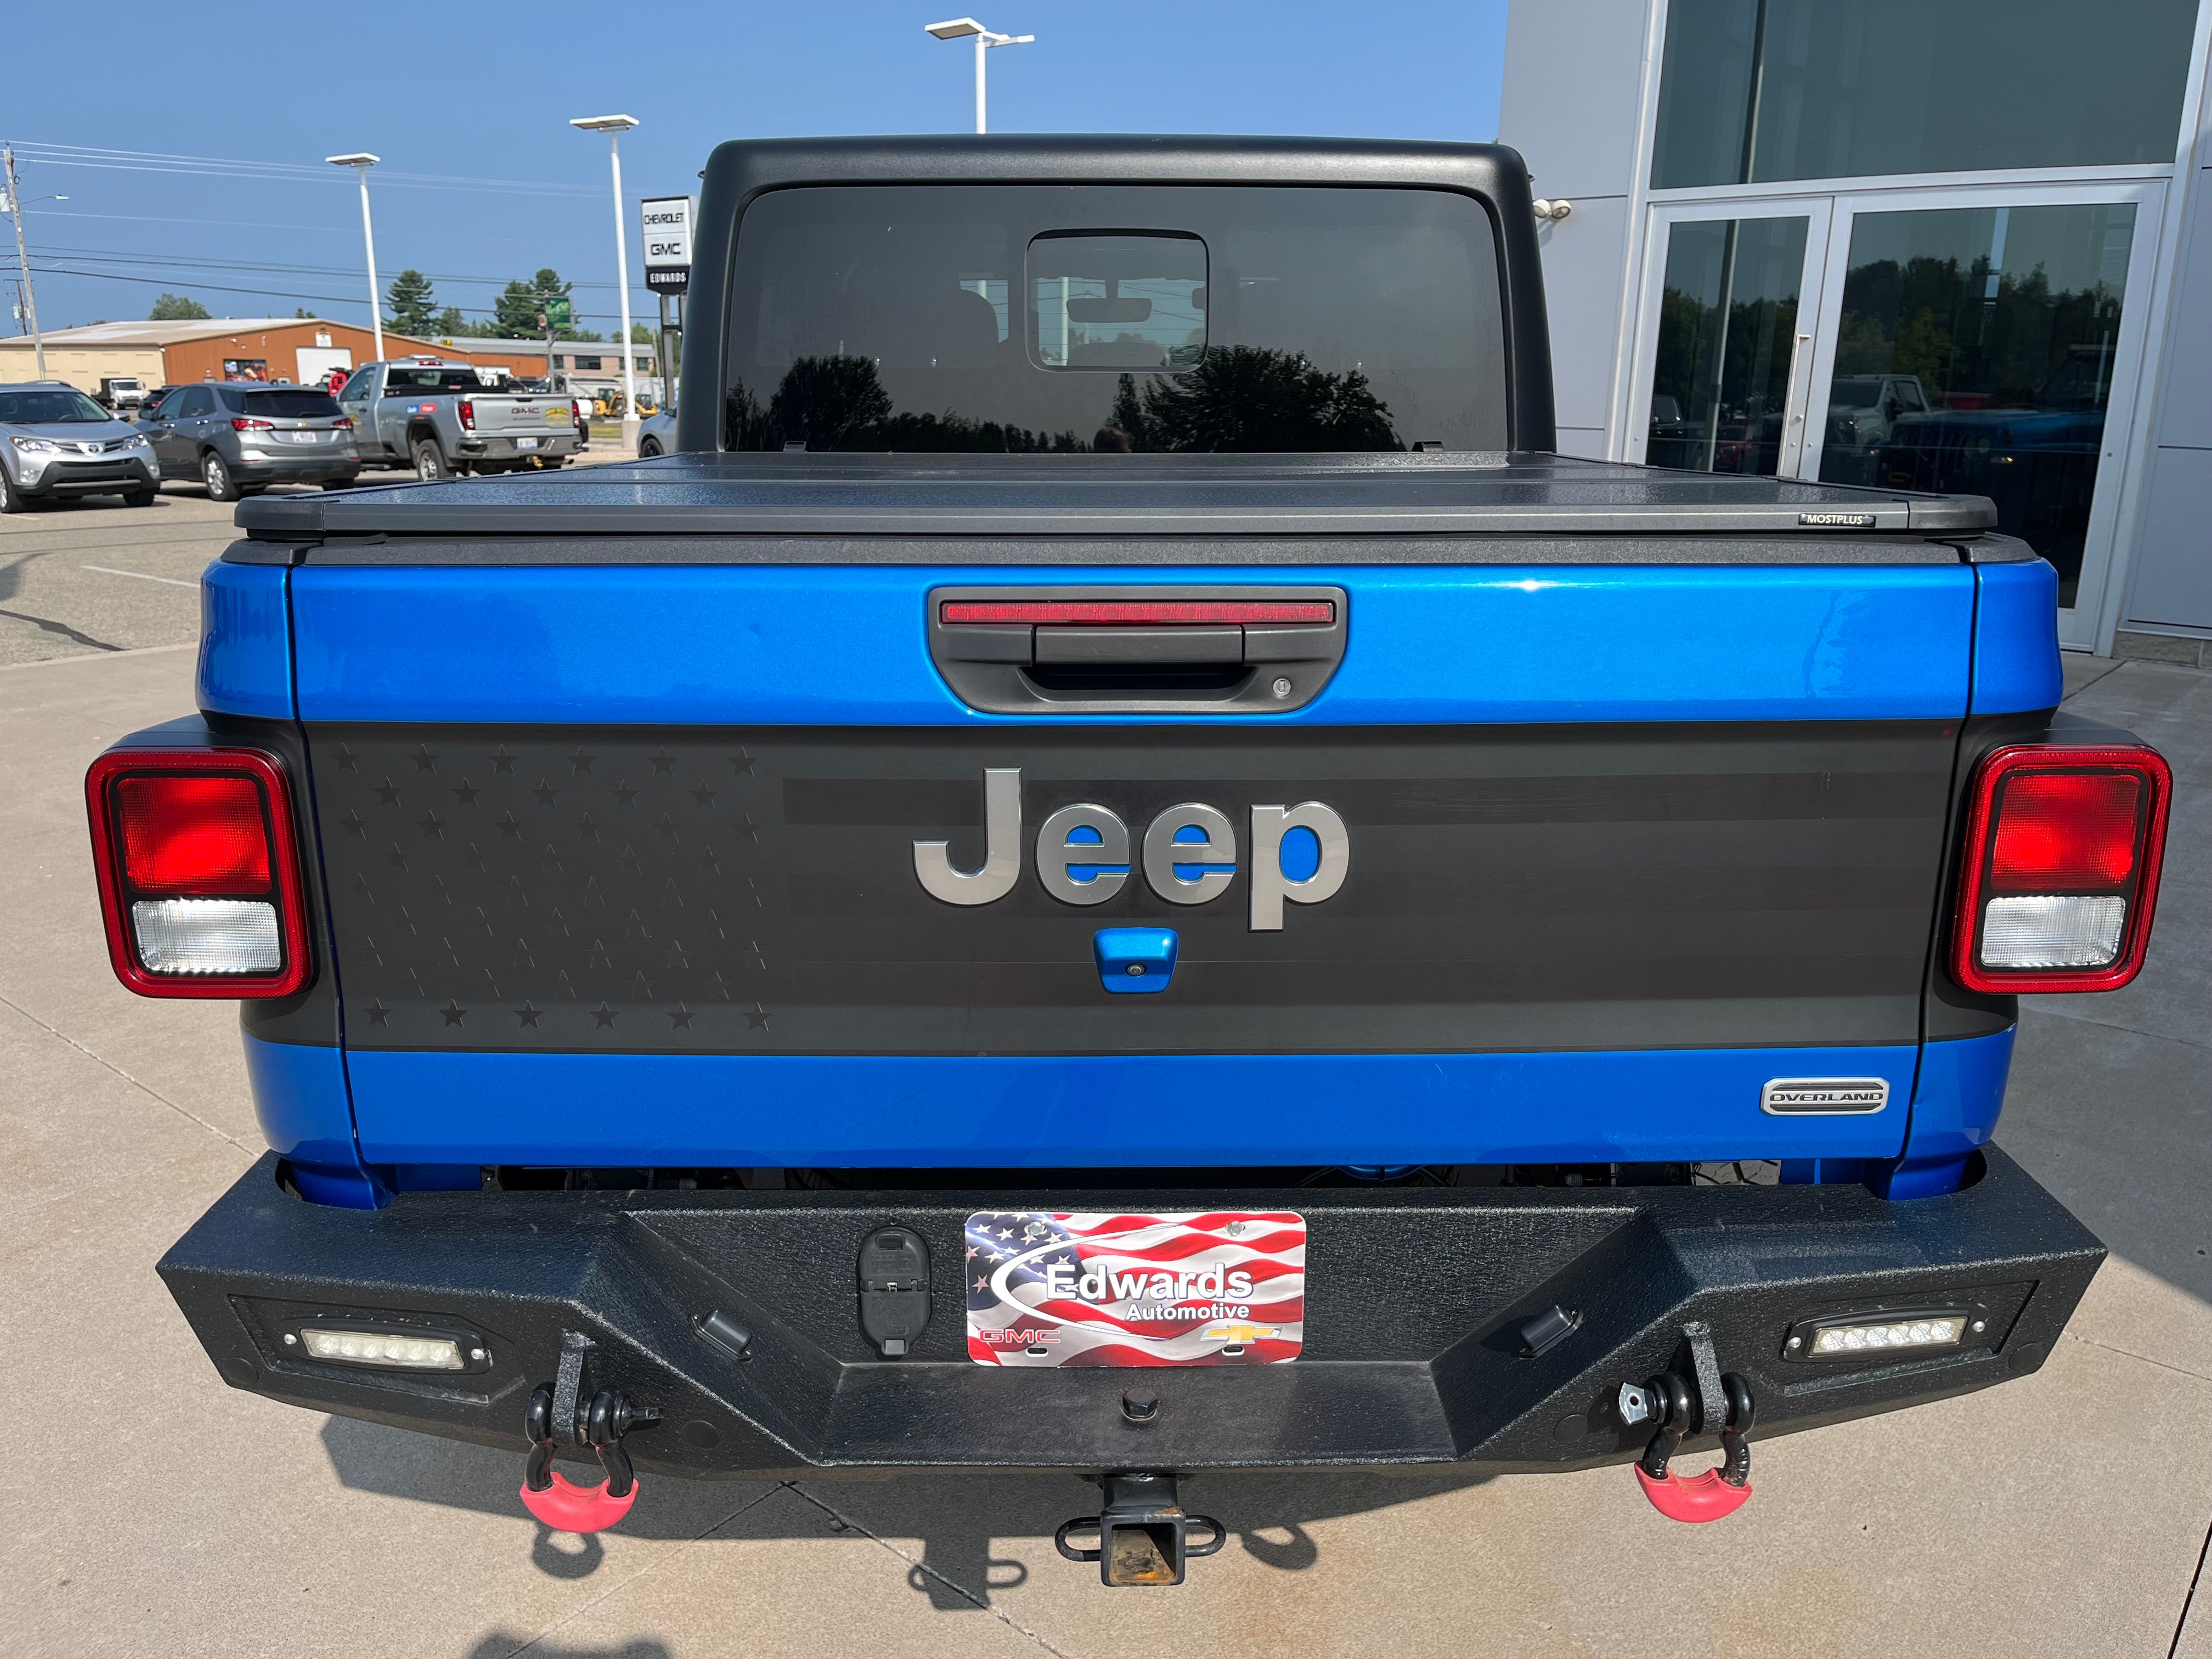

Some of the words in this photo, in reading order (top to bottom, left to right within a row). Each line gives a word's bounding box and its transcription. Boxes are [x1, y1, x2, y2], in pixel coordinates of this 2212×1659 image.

[644, 212, 684, 225] CHEVROLET
[651, 243, 681, 256] GMC
[650, 272, 687, 283] EDWARDS
[1807, 514, 1863, 525] MOSTPLUS
[913, 767, 1350, 932] Jeep
[1769, 1093, 1883, 1102] OVERLAND
[1046, 1262, 1254, 1300] Edwards
[1125, 1304, 1250, 1321] Automotive
[978, 1328, 1062, 1344] GMC
